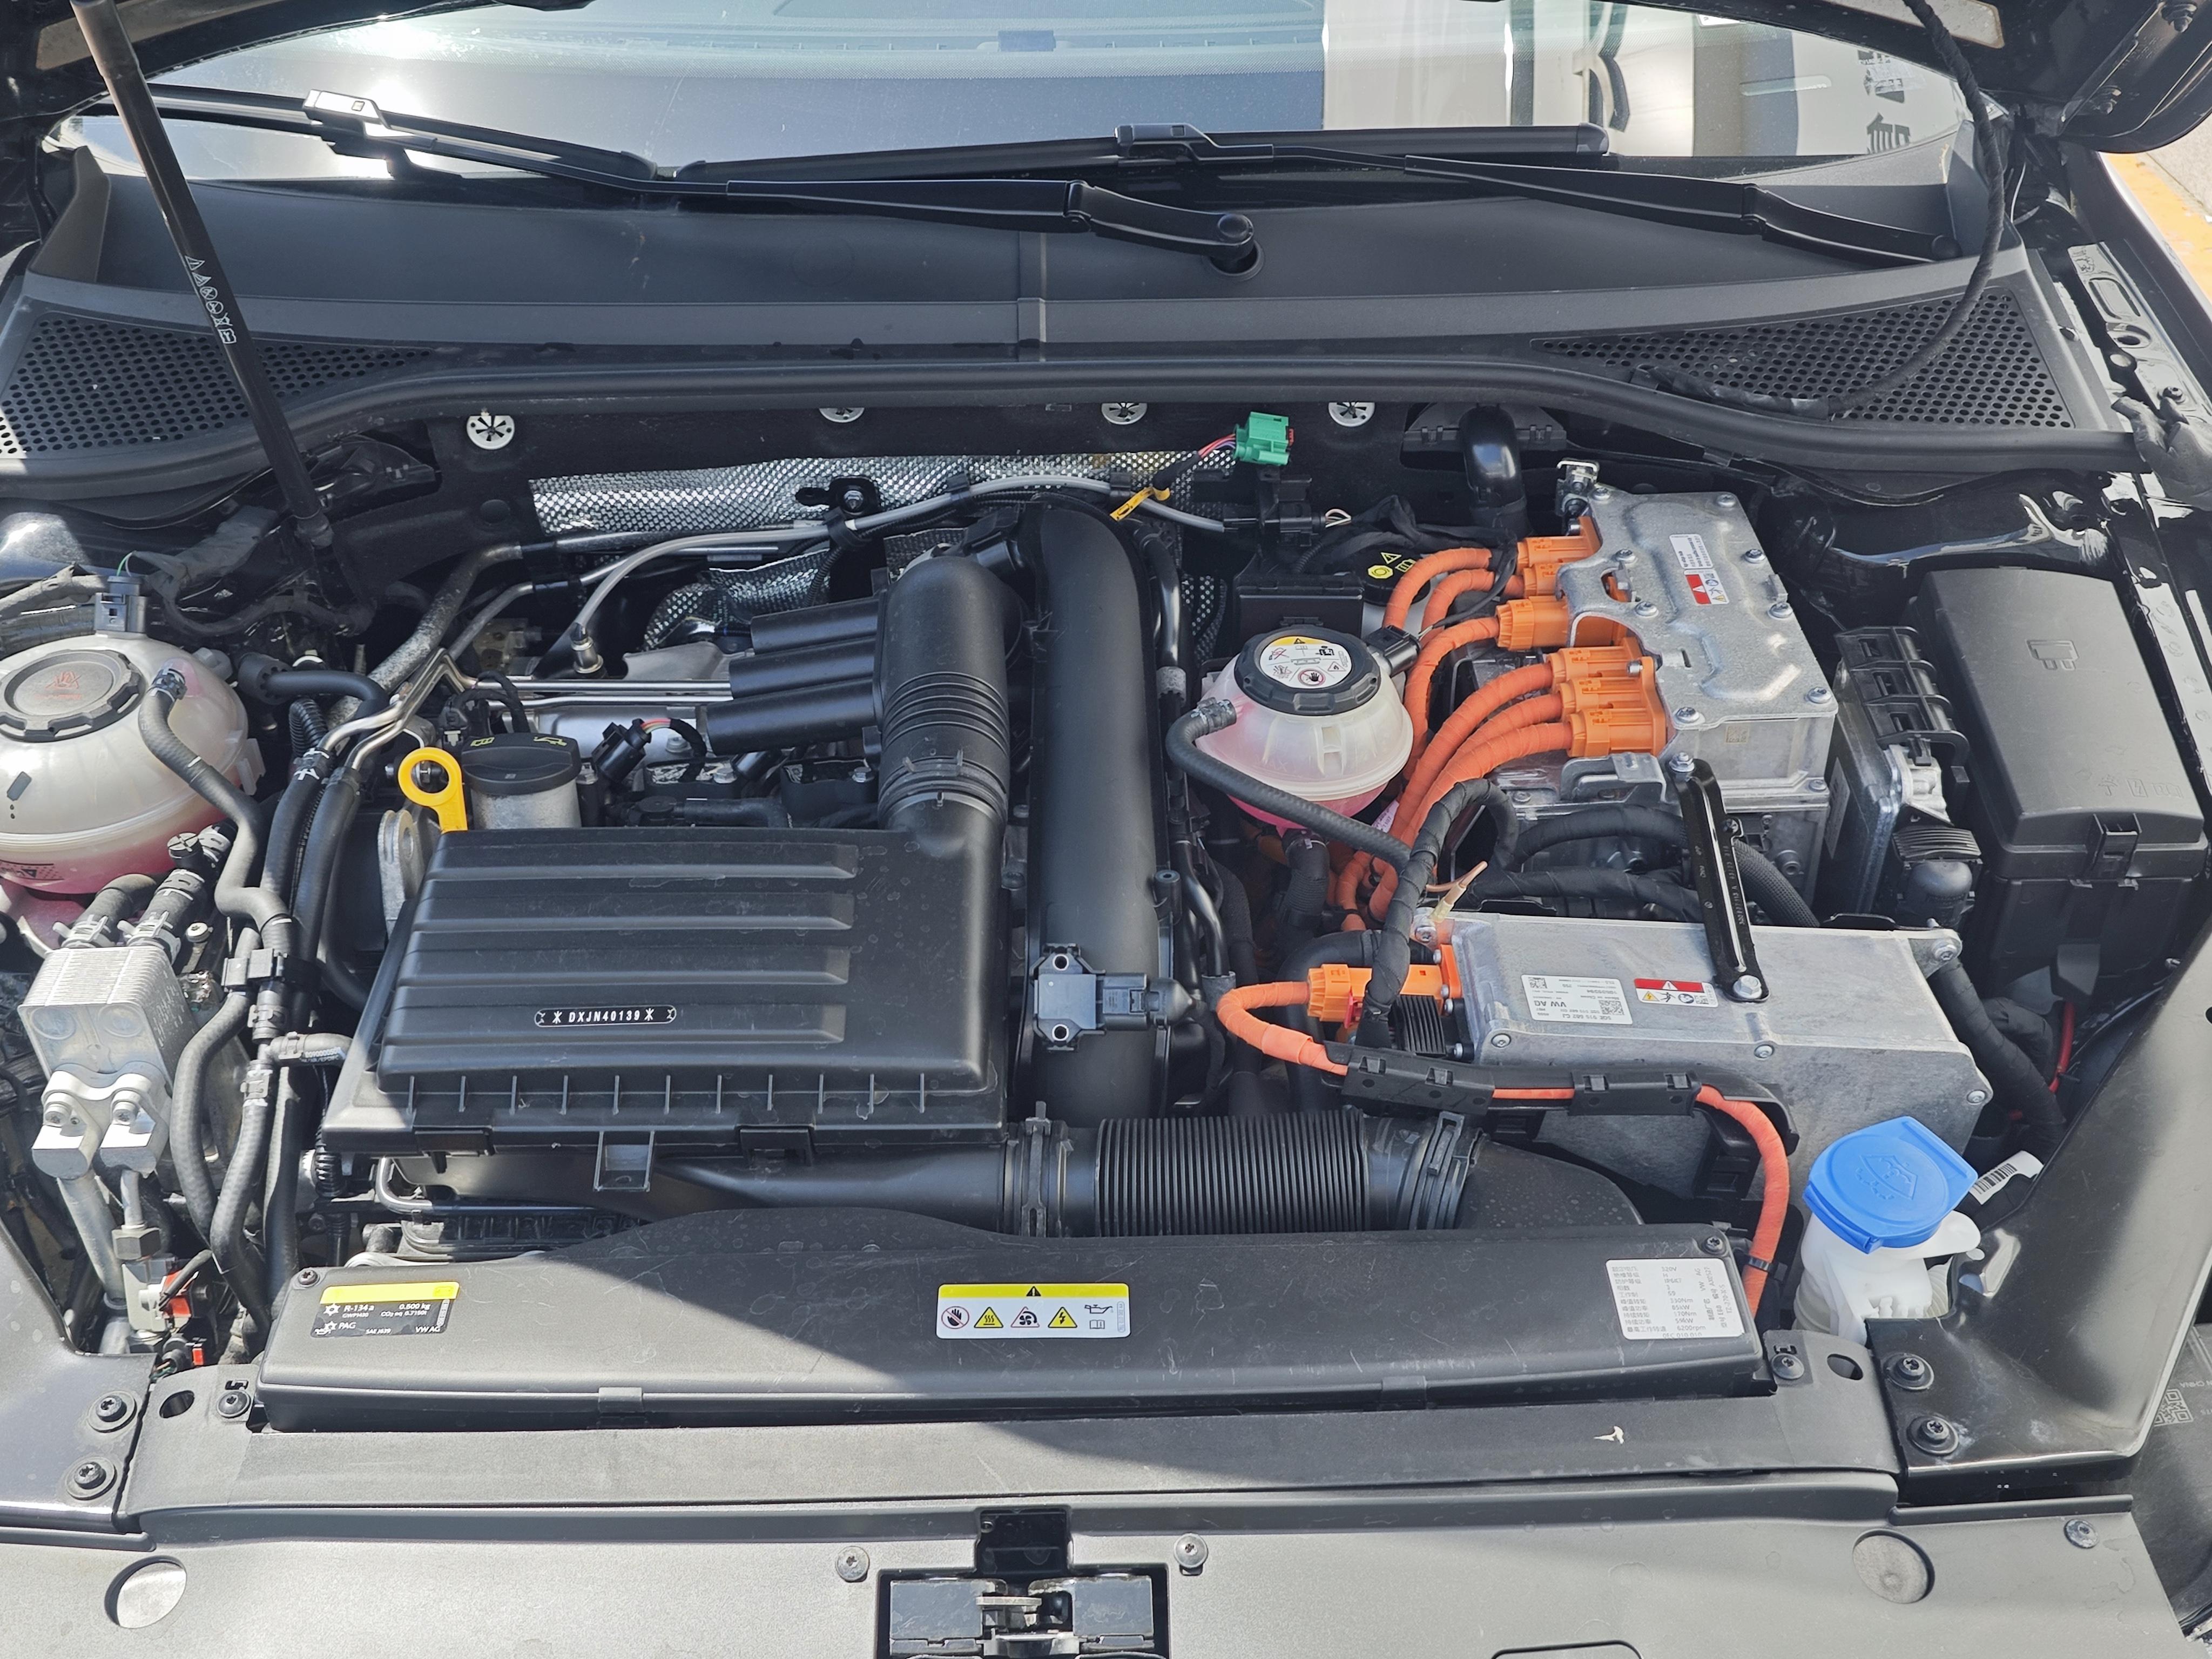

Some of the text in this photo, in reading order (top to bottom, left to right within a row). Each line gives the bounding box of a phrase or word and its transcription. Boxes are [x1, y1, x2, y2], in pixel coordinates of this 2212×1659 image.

[569, 1010, 640, 1022] DXJN40139
[1698, 1282, 1705, 1291] VW
[421, 1303, 431, 1311] kg
[338, 1321, 356, 1330] PAG
